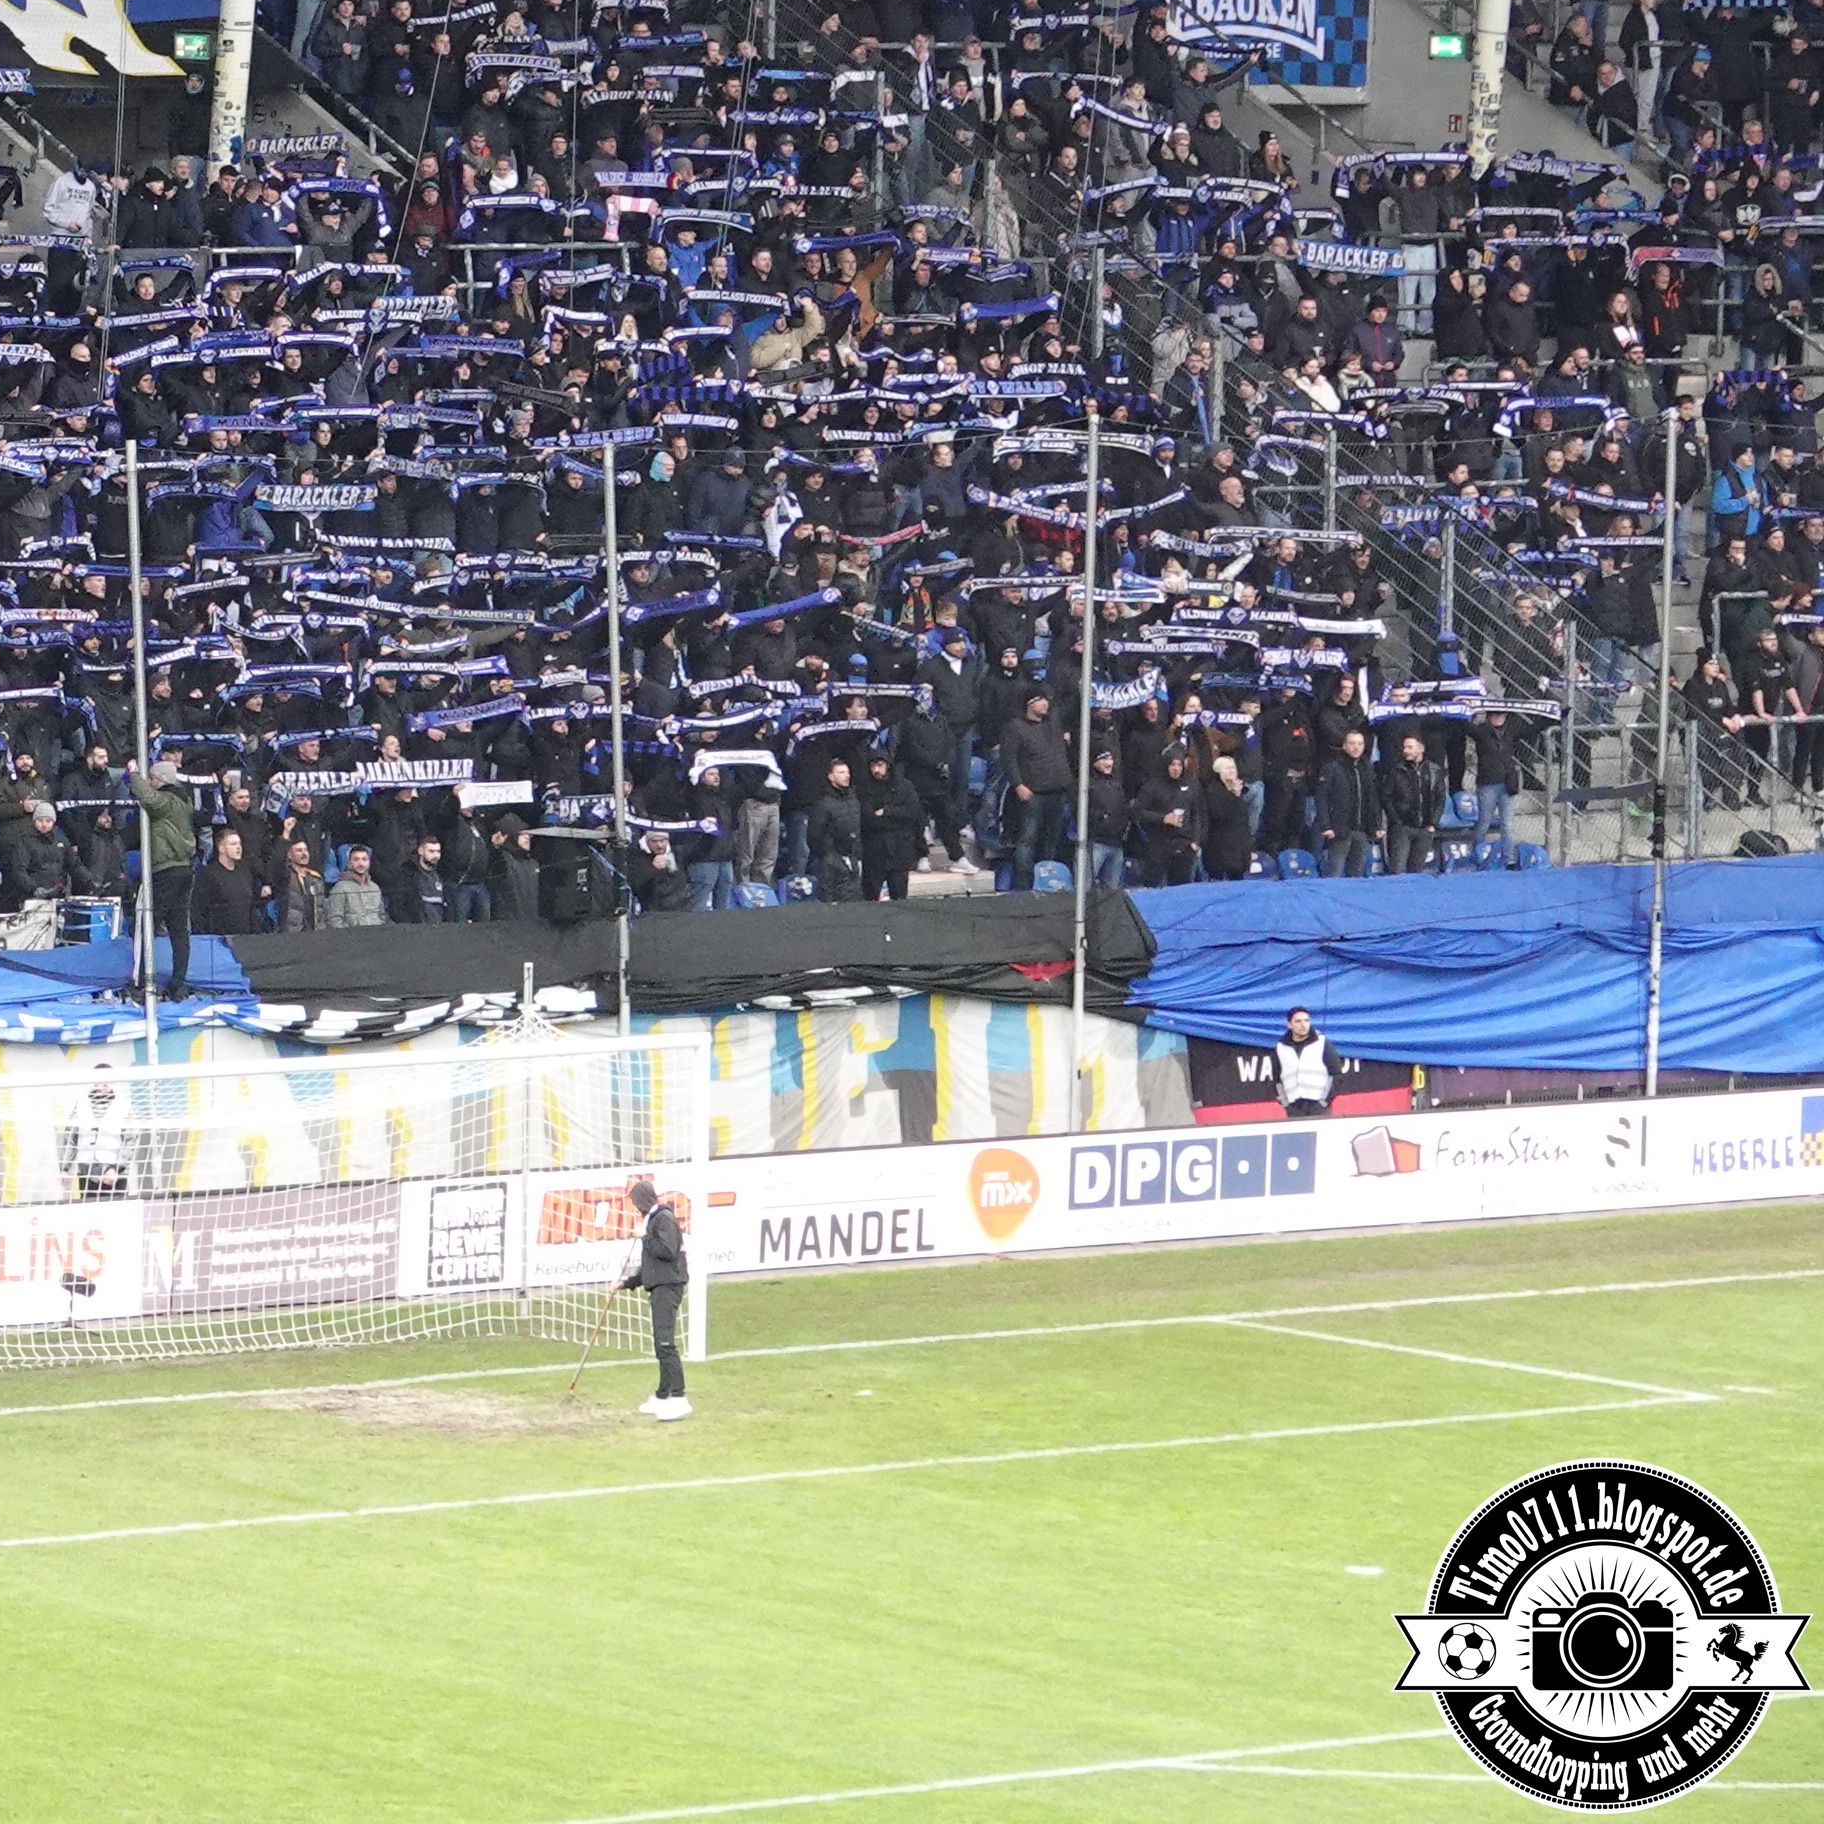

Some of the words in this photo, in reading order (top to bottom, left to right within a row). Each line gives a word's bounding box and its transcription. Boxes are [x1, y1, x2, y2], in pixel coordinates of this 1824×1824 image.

[259, 136, 340, 153] BARACKLER
[1306, 243, 1389, 268] BARACKLER
[274, 485, 358, 509] BARACKLER
[1692, 1136, 1794, 1176] HEBERLE
[1074, 1146, 1216, 1210] DPG
[432, 1223, 502, 1256] REWE
[758, 1207, 936, 1264] MANDEL
[430, 1254, 504, 1284] CENTER
